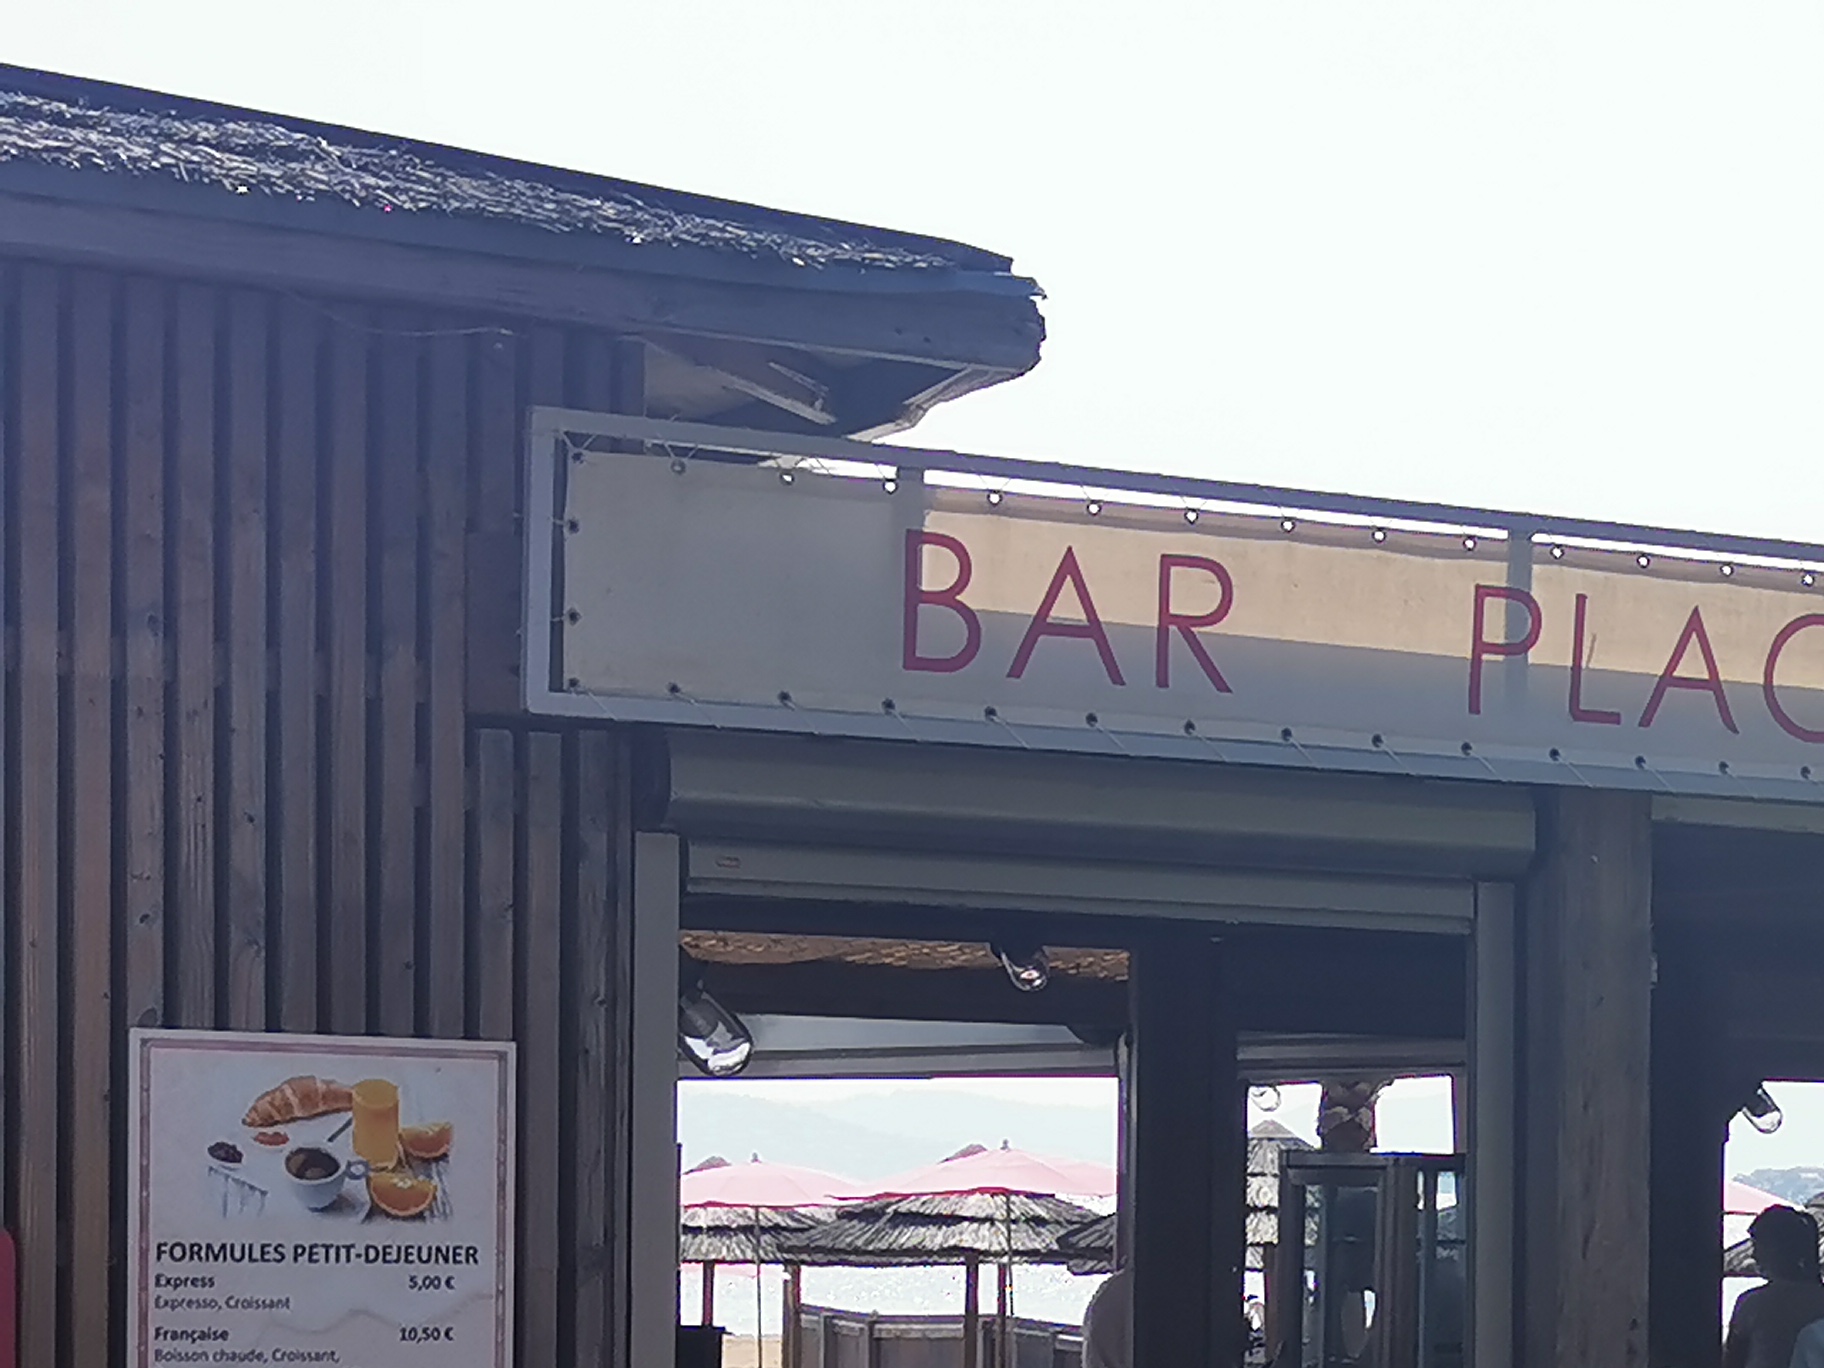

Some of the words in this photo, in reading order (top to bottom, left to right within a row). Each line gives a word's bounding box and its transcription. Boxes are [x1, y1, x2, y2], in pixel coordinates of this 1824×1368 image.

[901, 528, 1235, 695] BAR
[155, 1241, 286, 1264] FORMULES
[292, 1242, 480, 1266] PETIT-DEJEUNER
[154, 1273, 216, 1291] Express
[408, 1274, 441, 1291] 5,00
[444, 1275, 456, 1290] €
[154, 1294, 223, 1312] Expresso,
[225, 1295, 291, 1310] Croissant
[154, 1326, 230, 1345] Française
[399, 1326, 441, 1344] 10,50
[444, 1326, 454, 1341] €
[154, 1348, 210, 1363] Boisson
[212, 1348, 269, 1364] chaude,
[272, 1348, 340, 1364] Croissant,
